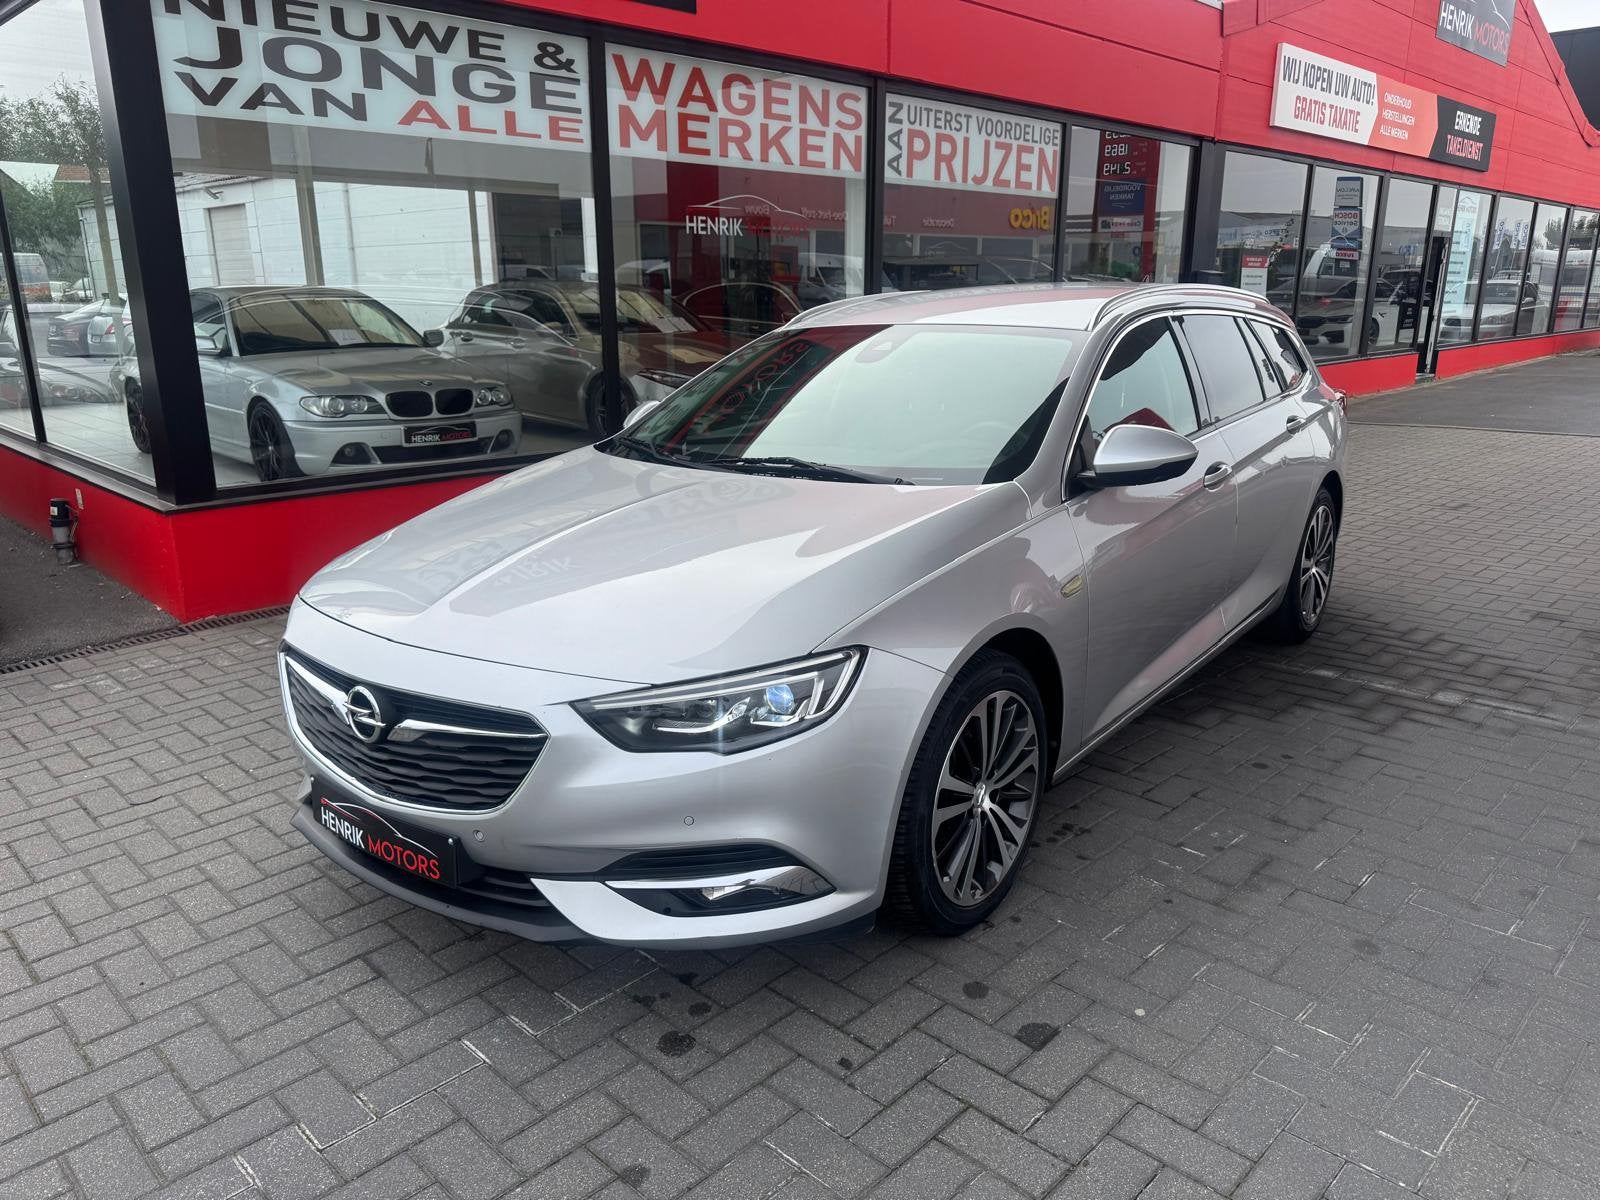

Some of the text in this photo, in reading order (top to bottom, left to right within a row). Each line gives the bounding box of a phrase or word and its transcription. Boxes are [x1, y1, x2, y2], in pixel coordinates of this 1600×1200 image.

[165, 0, 579, 74] NIEUWE &
[1439, 1, 1511, 55] HENRIK MOTORS
[172, 26, 582, 114] JONGE
[611, 53, 863, 131] WAGENS
[1282, 55, 1376, 106] WIJ KOPEN UW AUTO!
[173, 71, 584, 143] VAN ALLE
[907, 104, 1060, 146] UITERST VOORDELIGE
[1293, 95, 1360, 133] GRATIS TAXATIE
[1384, 92, 1412, 109] ONDERHOUD
[1455, 110, 1482, 135] ERKENDE
[618, 104, 863, 173] MERKEN
[887, 101, 904, 176] AAN
[906, 128, 1058, 192] PRIJZEN
[1446, 134, 1484, 161] TAKELDIENST
[685, 215, 744, 237] HENRIK
[411, 434, 440, 443] HENRIK
[320, 806, 441, 879] HENRIK MOTORS
